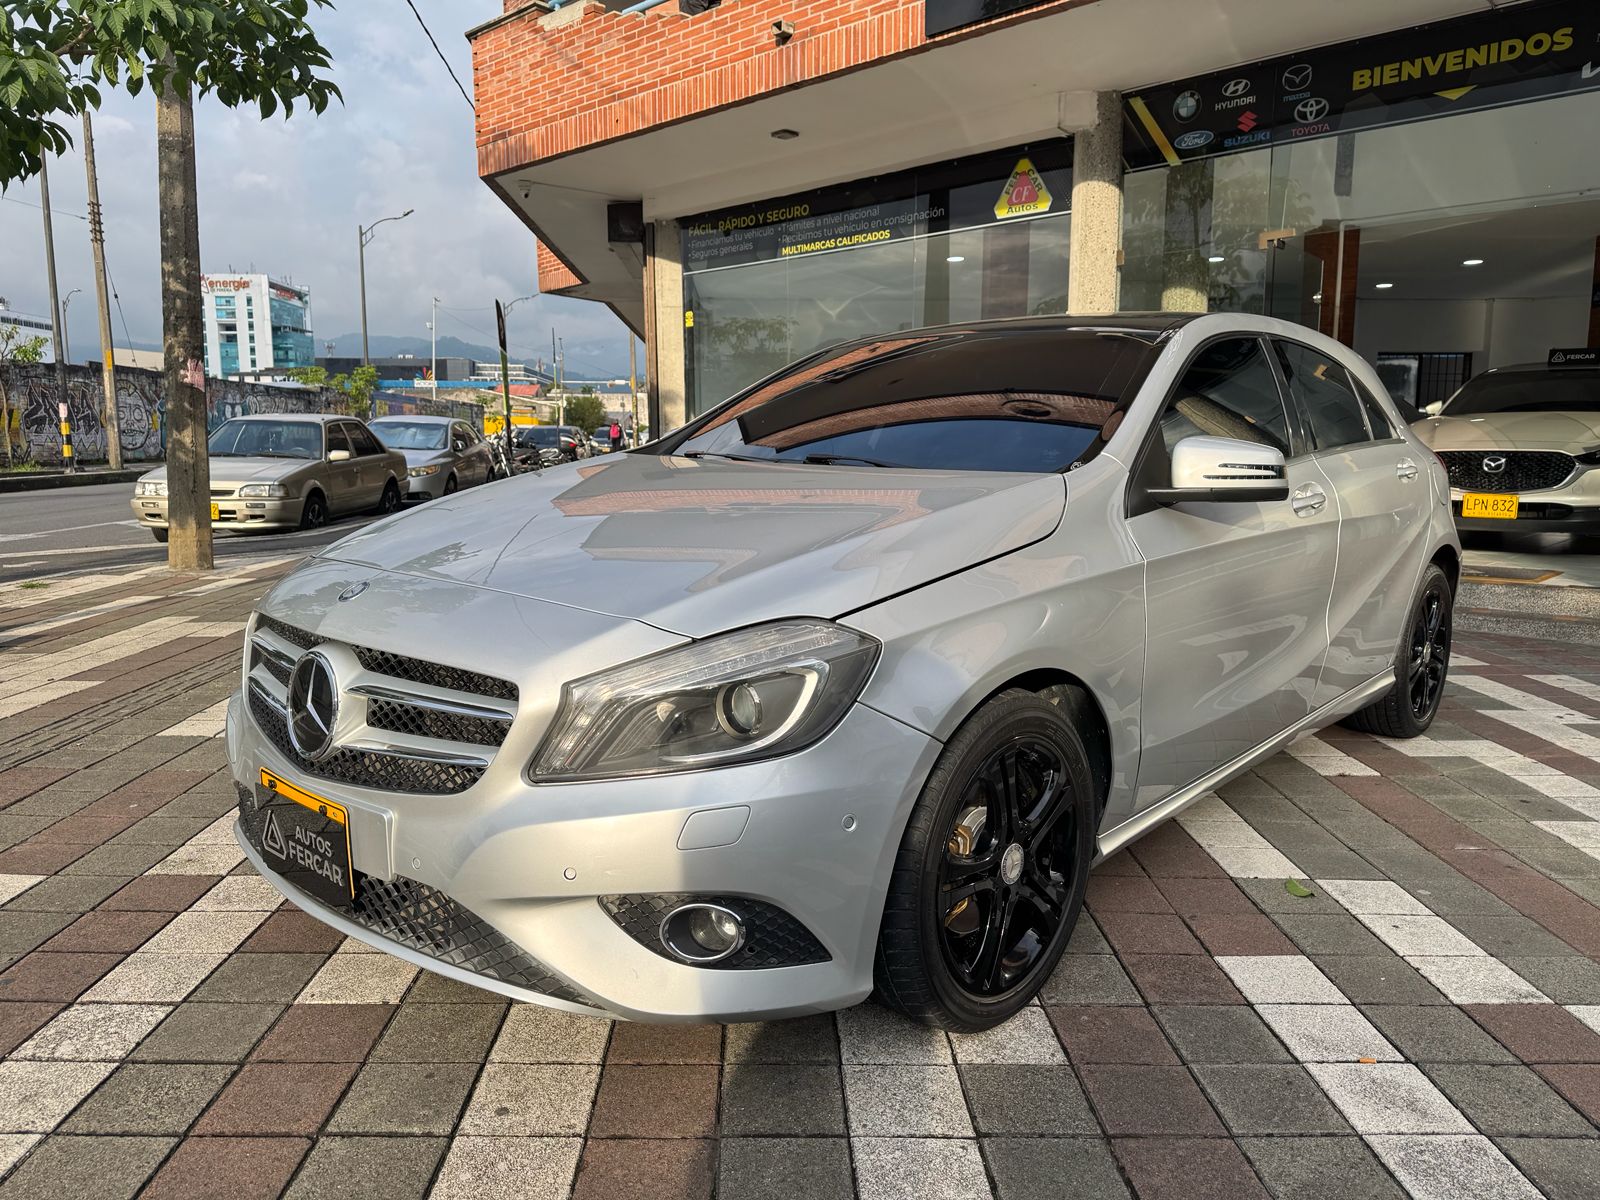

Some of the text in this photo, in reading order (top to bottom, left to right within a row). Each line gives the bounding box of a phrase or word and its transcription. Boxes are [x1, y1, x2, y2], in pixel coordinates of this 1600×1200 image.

[1352, 26, 1574, 91] BIENVENIDOS
[1215, 95, 1257, 111] HYUNDAI
[1224, 131, 1271, 147] SUZUKI
[1291, 123, 1330, 137] TOYOTA
[1004, 170, 1020, 196] FER
[1027, 168, 1043, 192] CAR
[718, 215, 756, 231] RÁPIDO
[756, 212, 766, 224] Y
[766, 204, 810, 223] SEGURO
[816, 218, 822, 227] a
[822, 213, 842, 225] nivel
[843, 206, 880, 222] nacional
[1006, 203, 1039, 214] Autos
[782, 230, 822, 244] Recibimos
[823, 226, 833, 237] tu
[870, 220, 882, 229] en
[883, 206, 945, 226] consignación
[735, 232, 743, 241] tu
[782, 229, 891, 256] MULTIMARCAS CALIFICADOS
[692, 241, 754, 260] Seguros generales
[1466, 498, 1515, 512] LPN 832
[295, 825, 333, 858] AUTOS
[288, 840, 344, 887] FERCAR
